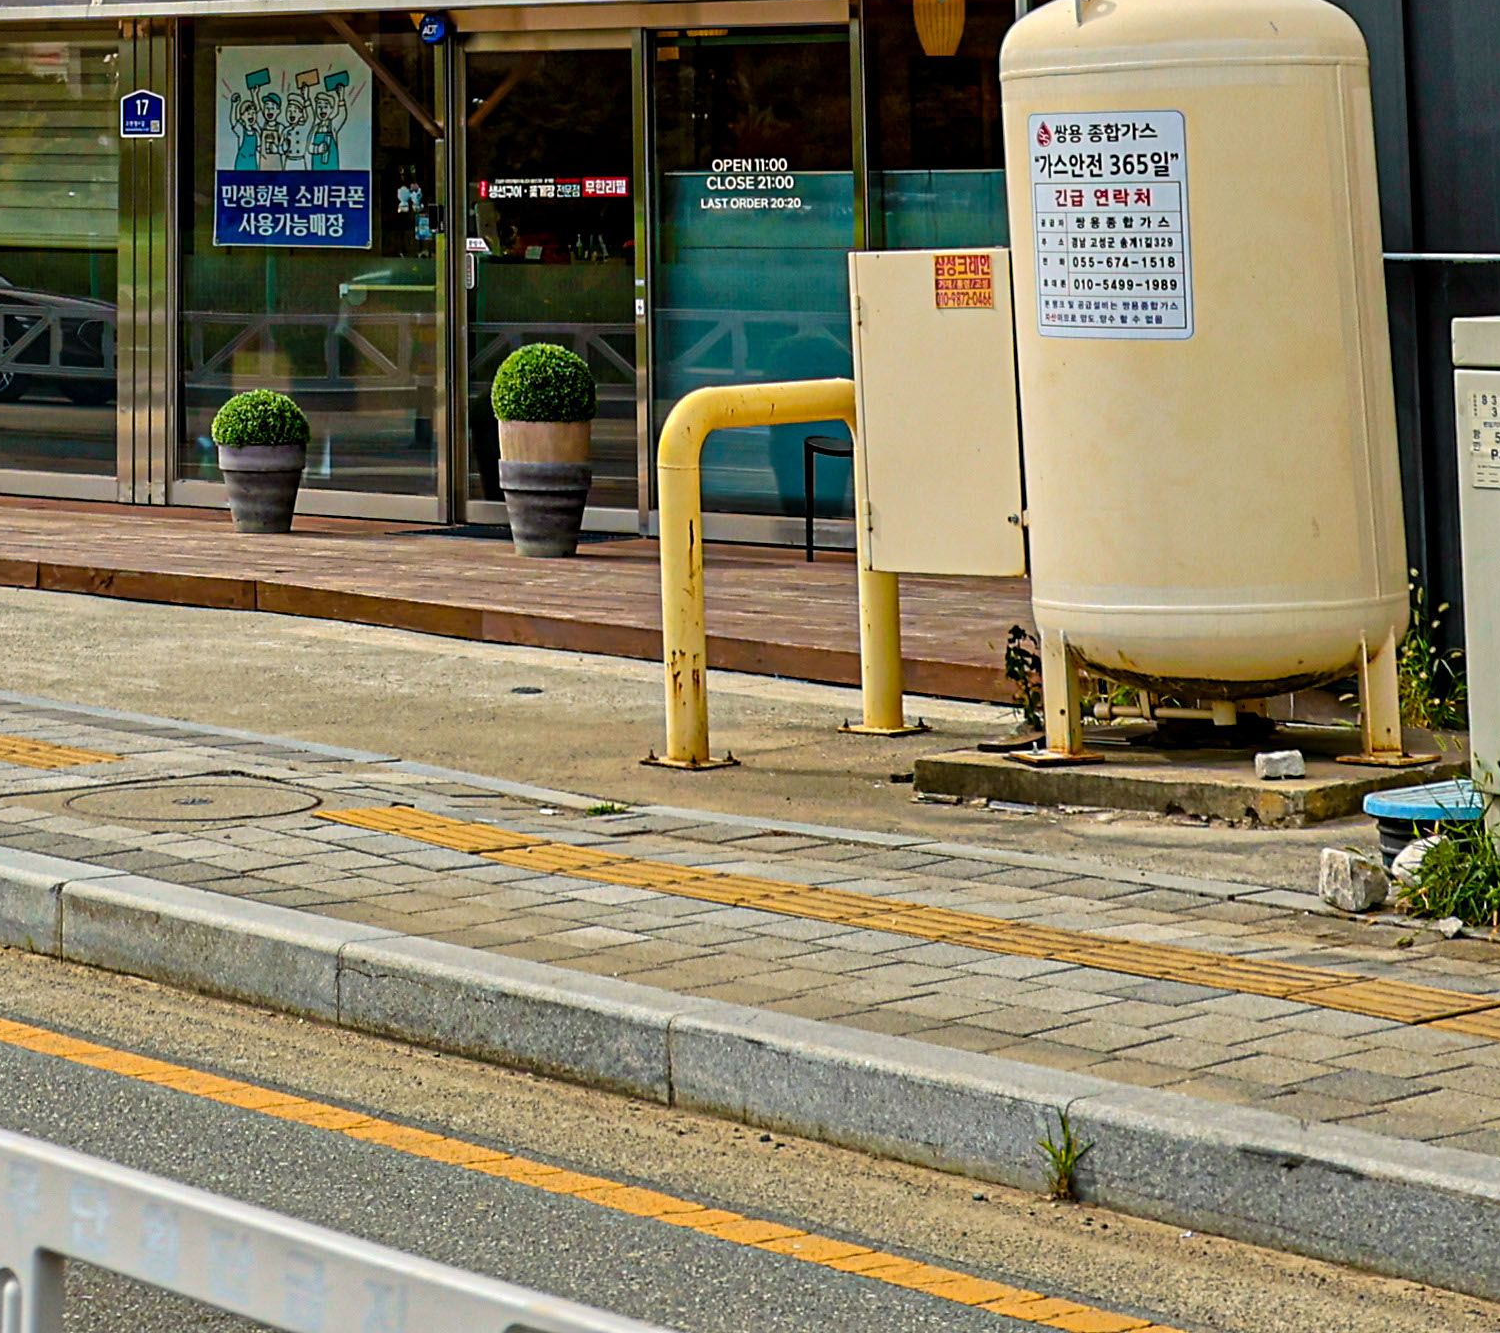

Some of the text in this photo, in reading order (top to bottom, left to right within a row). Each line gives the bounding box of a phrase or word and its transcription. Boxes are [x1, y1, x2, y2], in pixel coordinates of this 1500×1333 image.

[422, 25, 438, 34] ADT
[135, 99, 149, 116] 17
[1054, 122, 1158, 143] 쌍용 종합가스
[712, 158, 788, 172] OPEN 11:00
[706, 175, 795, 190] CLOSE 21:00
[221, 185, 366, 208] 민생회복 소비쿠폰
[700, 198, 801, 209] LAST ORDER 20:20
[1055, 188, 1151, 207] 긴급 연락처
[238, 213, 344, 237] 사용가능매장
[936, 255, 990, 276] 삼성크레인
[1072, 256, 1176, 268] 055-674-1518
[1074, 279, 1178, 291] 010-5499-1989
